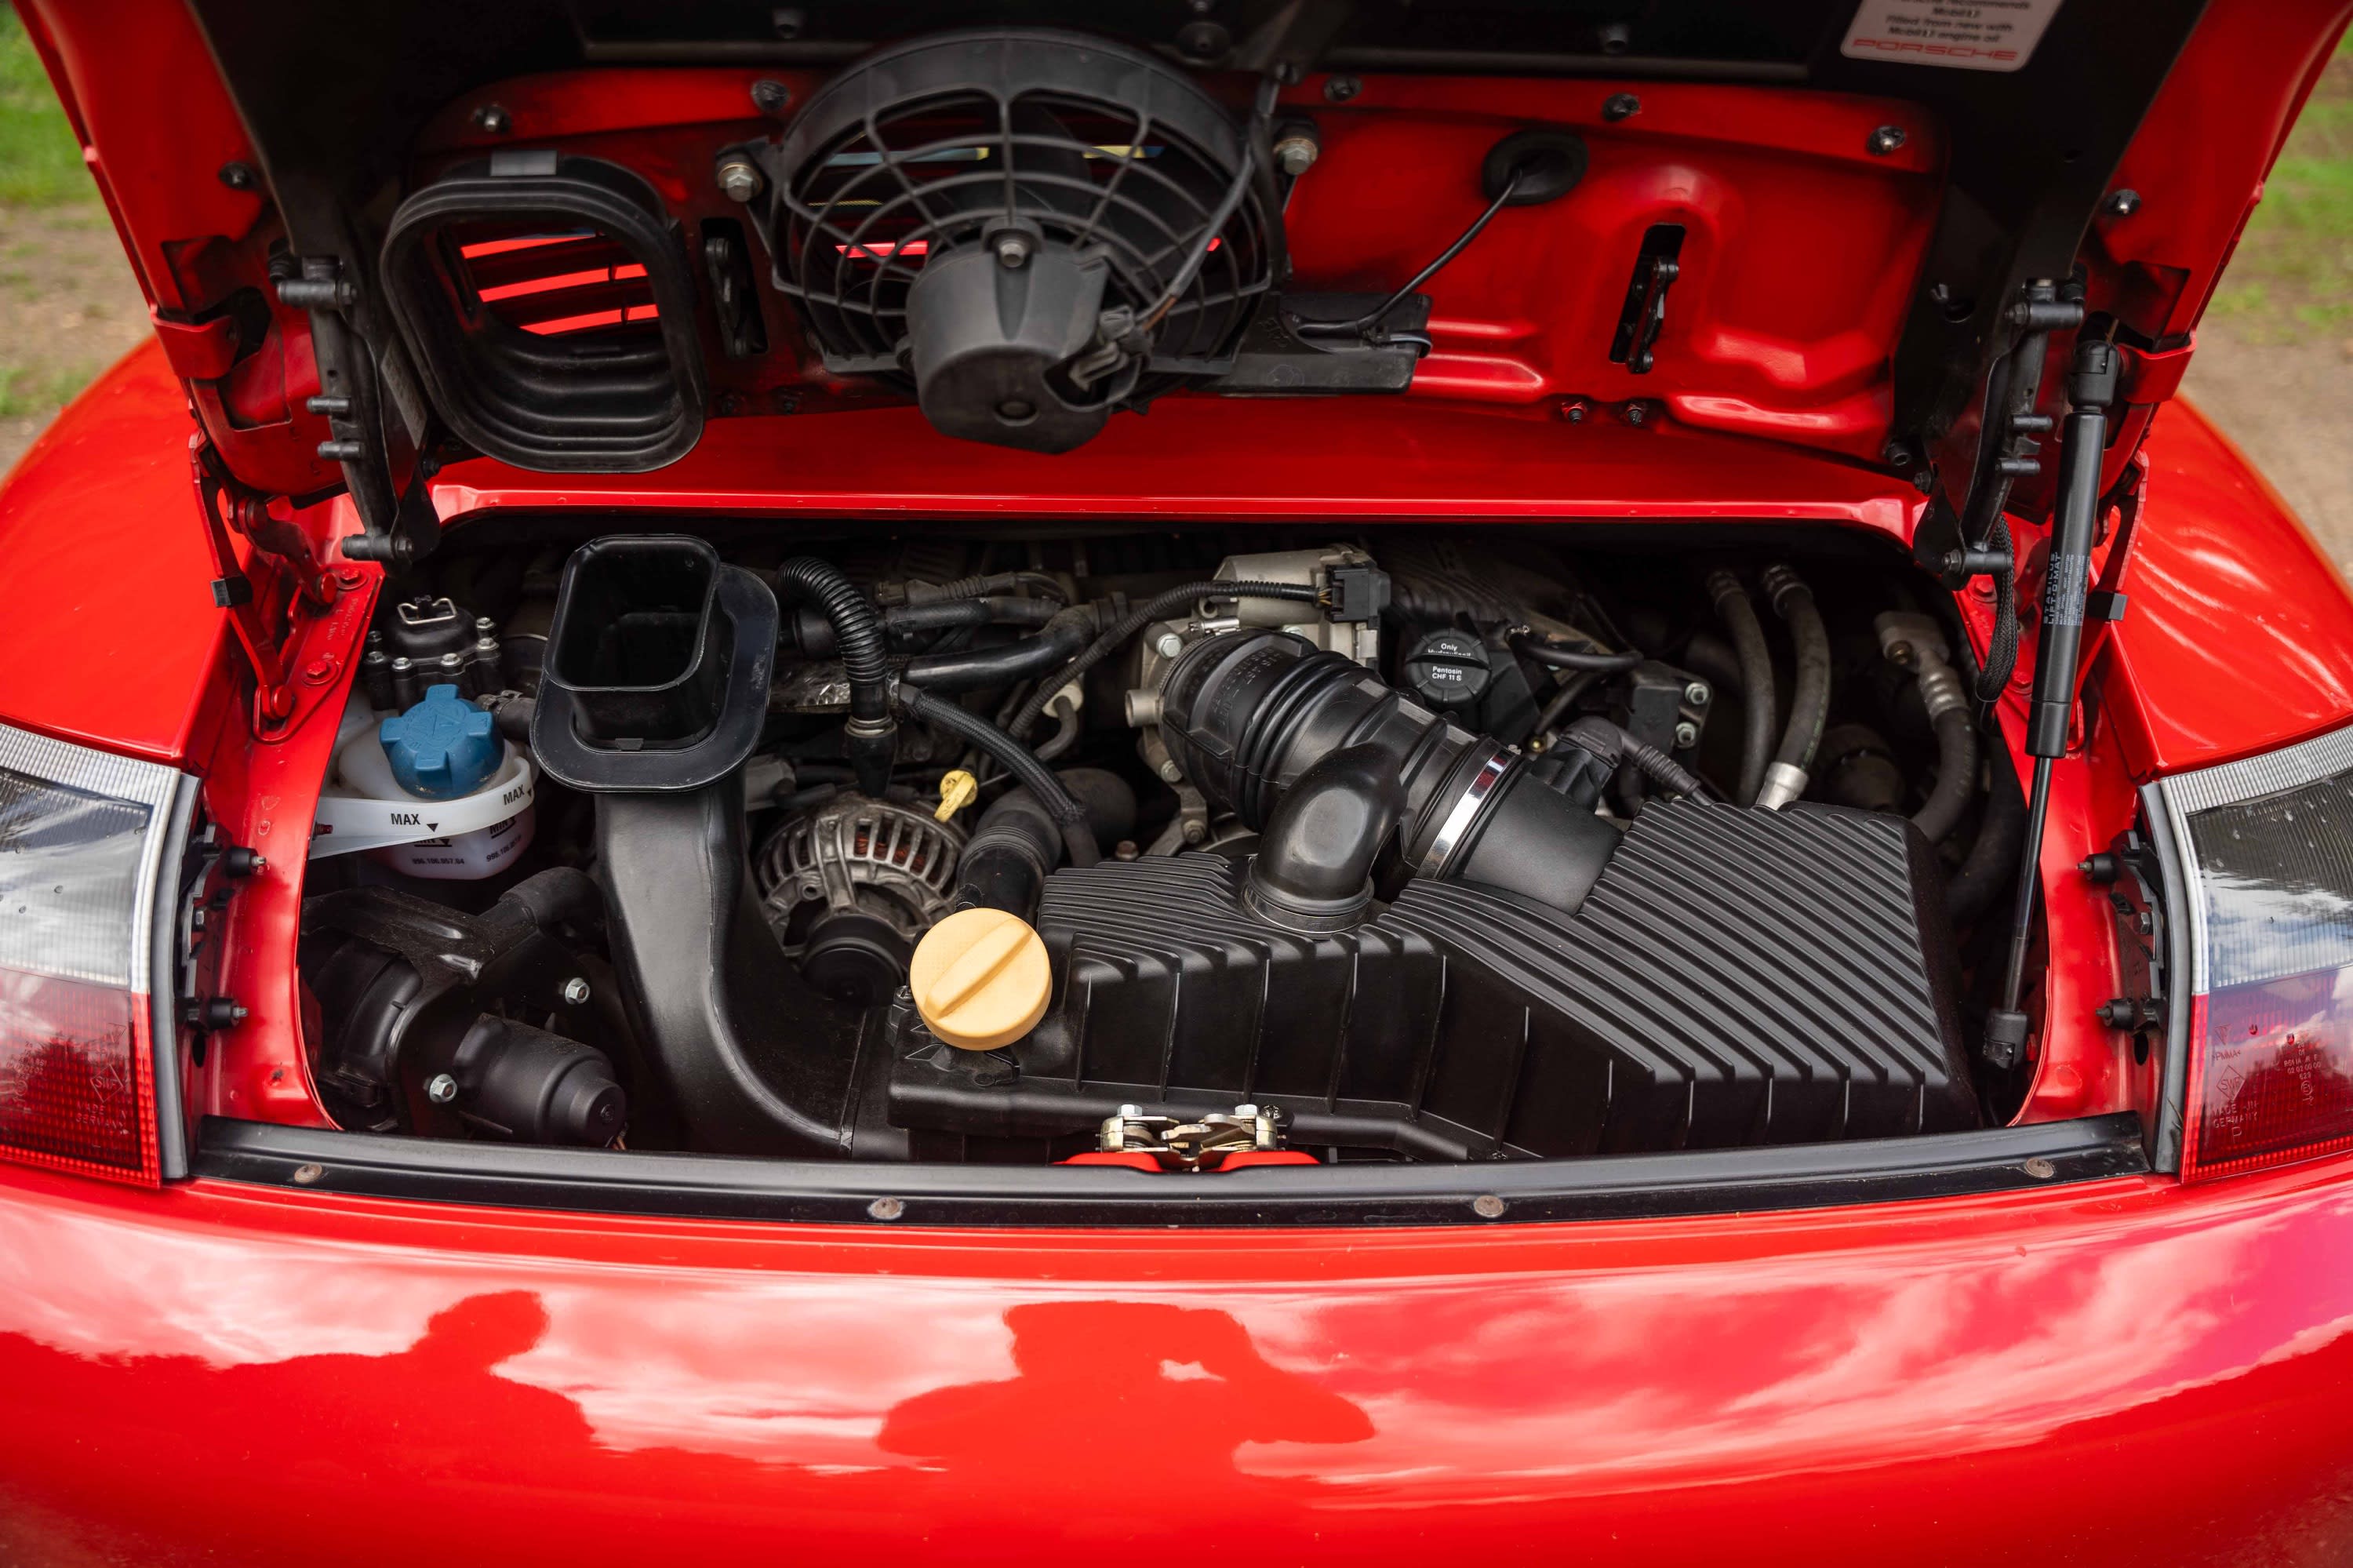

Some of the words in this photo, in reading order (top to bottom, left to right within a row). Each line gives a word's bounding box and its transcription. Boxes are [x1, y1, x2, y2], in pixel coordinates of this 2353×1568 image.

[1924, 17, 1951, 27] from
[1955, 20, 1983, 30] new
[1987, 21, 2013, 31] with
[1938, 31, 1980, 42] engine
[1853, 38, 2018, 60] PORSCHE
[1441, 642, 1457, 651] Only
[1432, 666, 1462, 675] Pentosin
[503, 784, 526, 806] MAX
[391, 813, 421, 825] MAX
